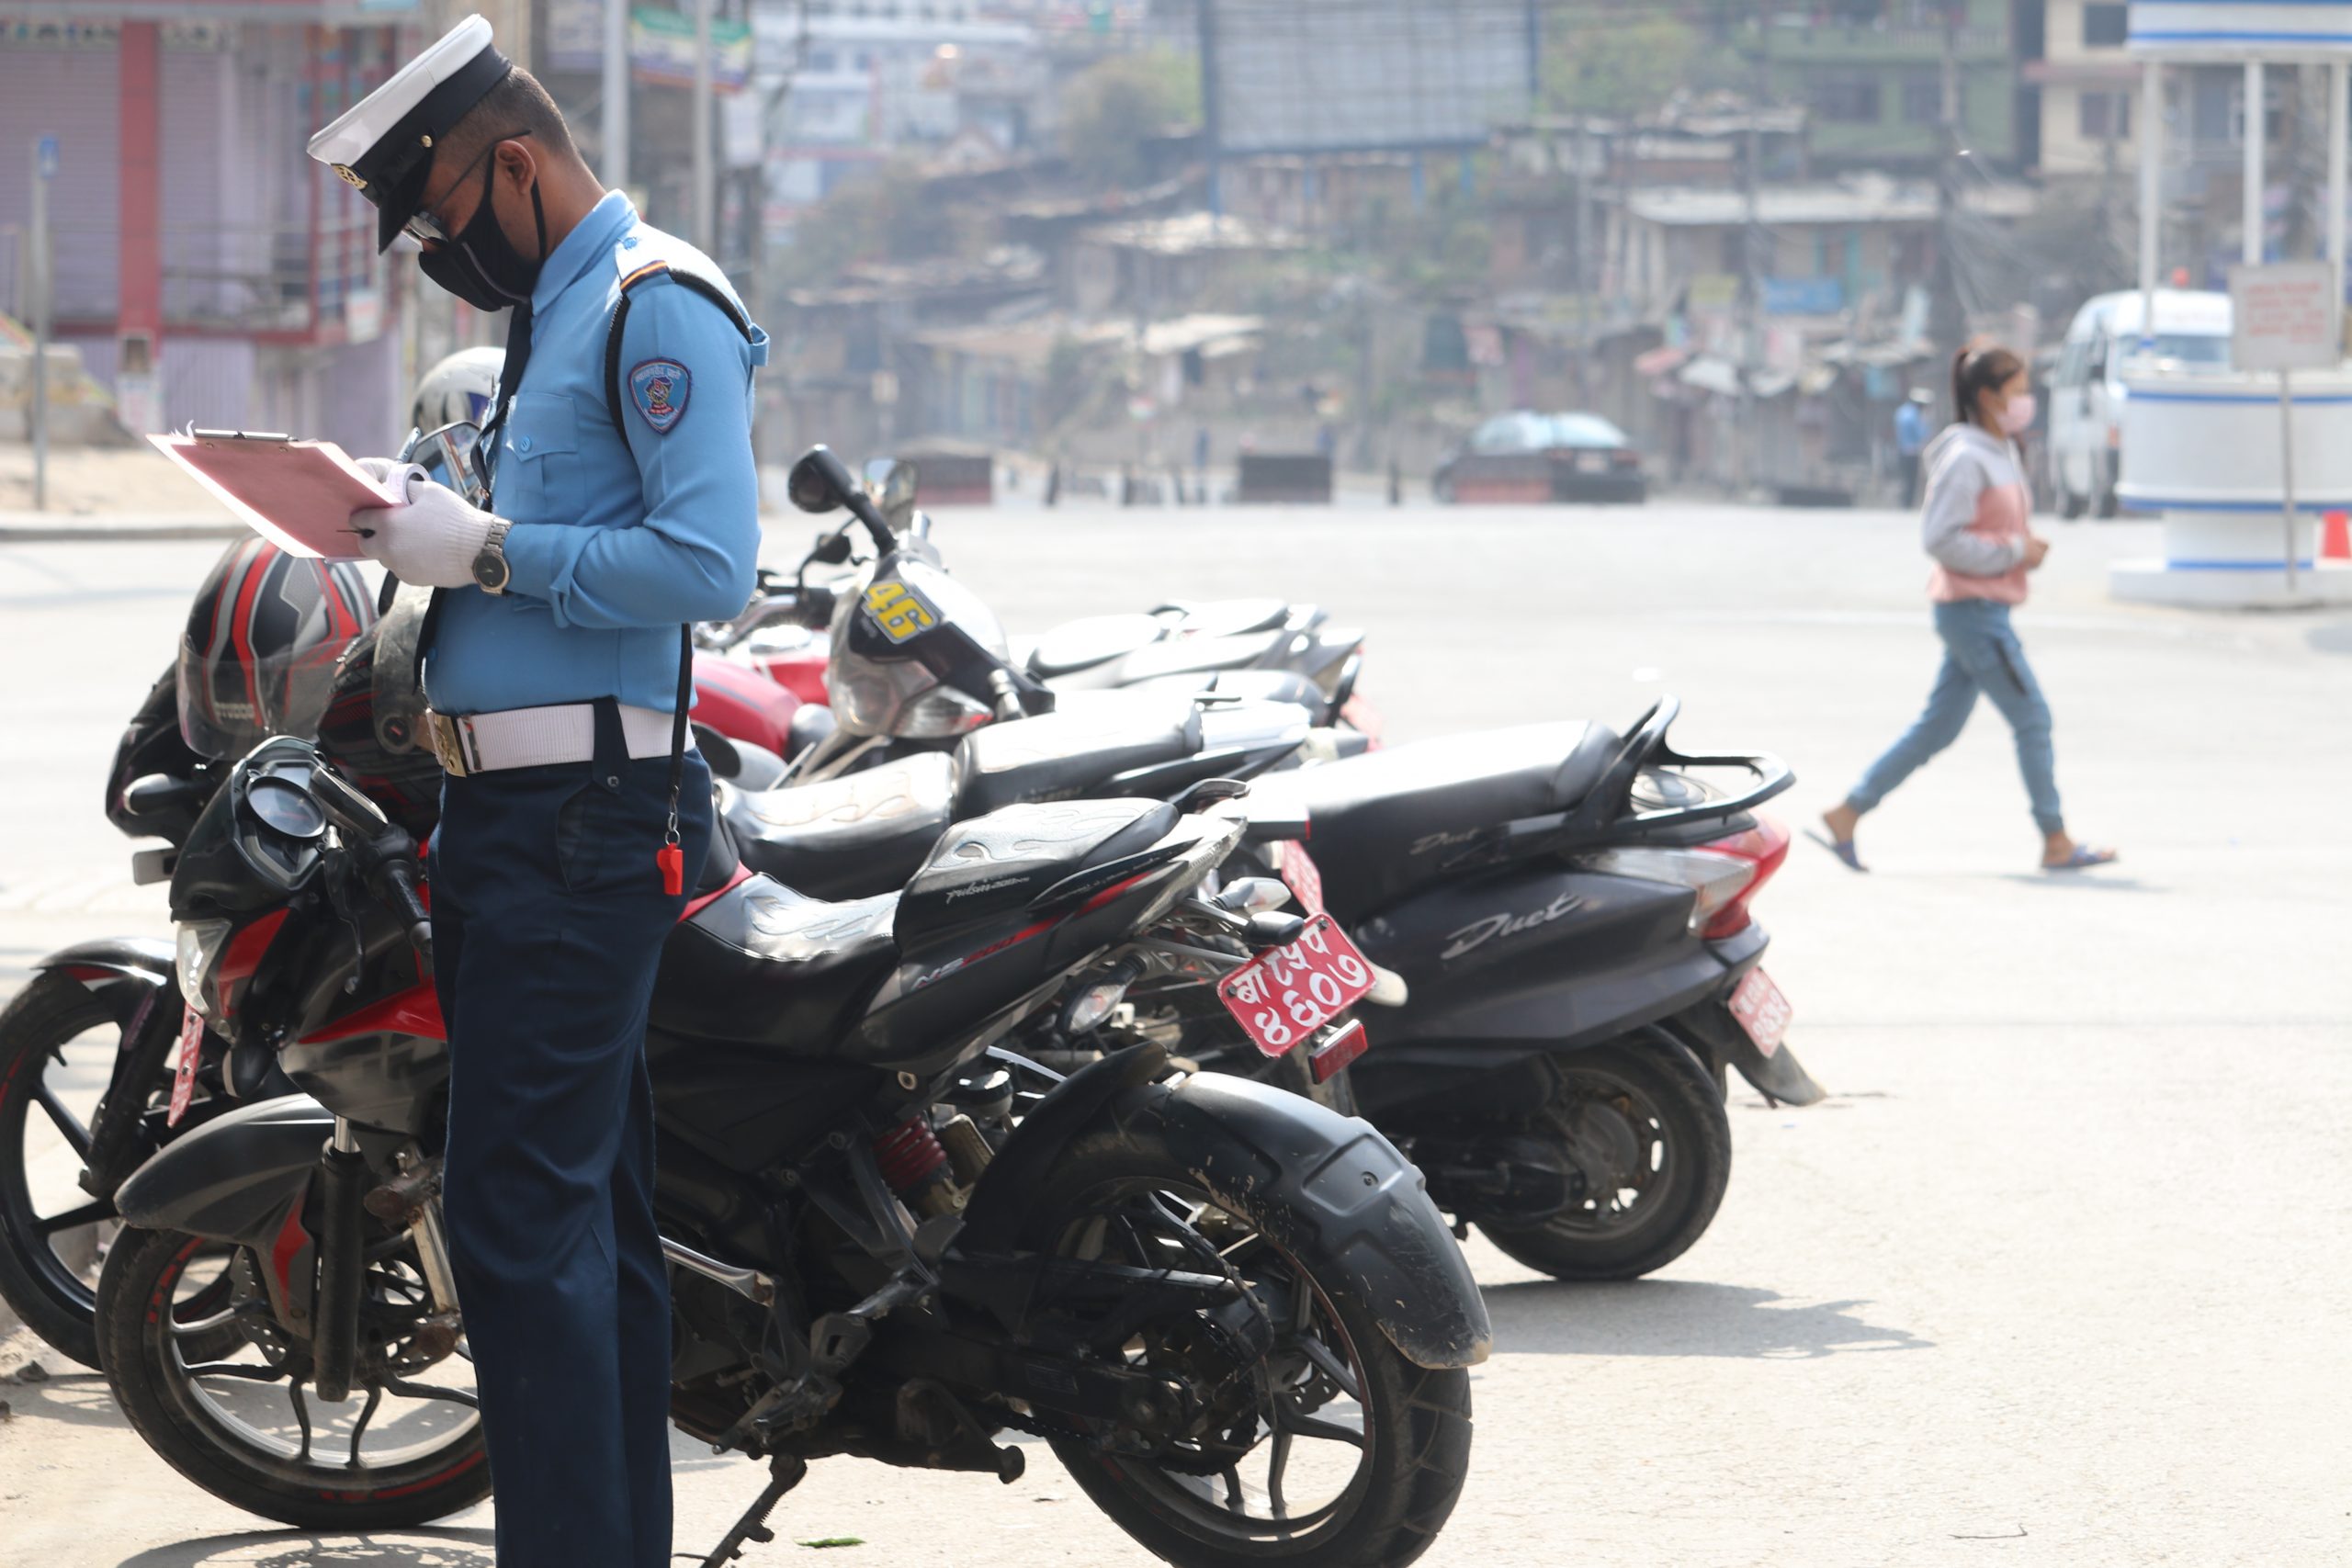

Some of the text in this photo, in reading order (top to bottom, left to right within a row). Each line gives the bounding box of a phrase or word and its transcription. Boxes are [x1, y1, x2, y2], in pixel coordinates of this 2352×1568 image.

[865, 581, 936, 641] 46
[1231, 963, 1271, 1004] बा
[1254, 953, 1367, 1045] ४६०७
